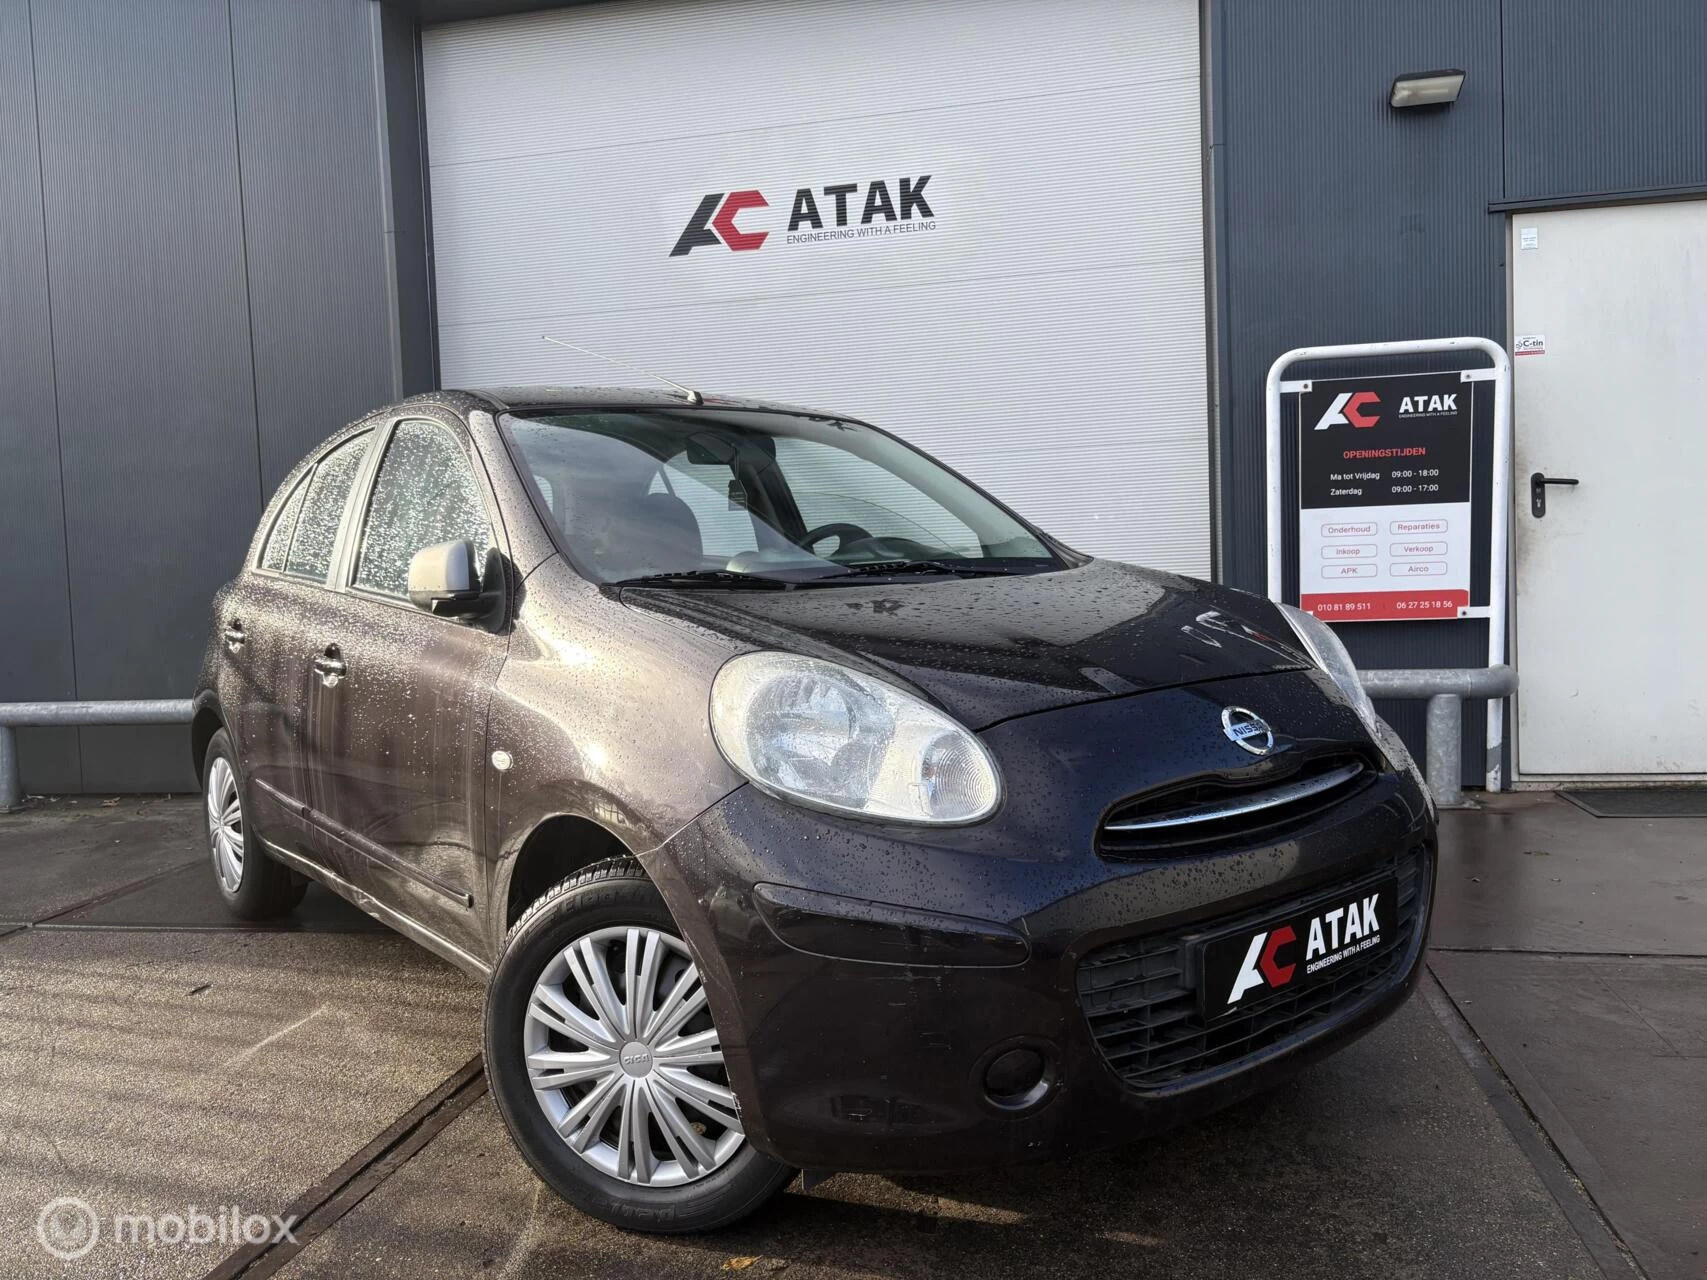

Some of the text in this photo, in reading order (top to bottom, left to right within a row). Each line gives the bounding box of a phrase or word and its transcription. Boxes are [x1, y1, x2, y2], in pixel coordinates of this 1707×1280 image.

[787, 175, 935, 232] ATAK
[786, 220, 937, 245] ENGINEERING WITH A FEELING
[1399, 394, 1458, 414] ATAK
[1343, 447, 1426, 459] OPENINGSTIJDEN
[1330, 473, 1342, 481] Ma
[1354, 472, 1380, 481] Vrijdag
[1391, 470, 1412, 478] 09:00
[1418, 469, 1439, 477] 18:00
[1330, 488, 1362, 496] Zaterdag
[1391, 485, 1412, 493] 09:00
[1328, 525, 1371, 534] Onderhoud
[1397, 522, 1440, 532] Reparaties
[1336, 548, 1361, 556] Inkoop
[1232, 723, 1265, 737] NISS
[1306, 893, 1380, 961] ATAK
[1306, 951, 1342, 974] ENGINEERING
[1342, 945, 1356, 958] WITH
[1360, 934, 1380, 951] FEELING
